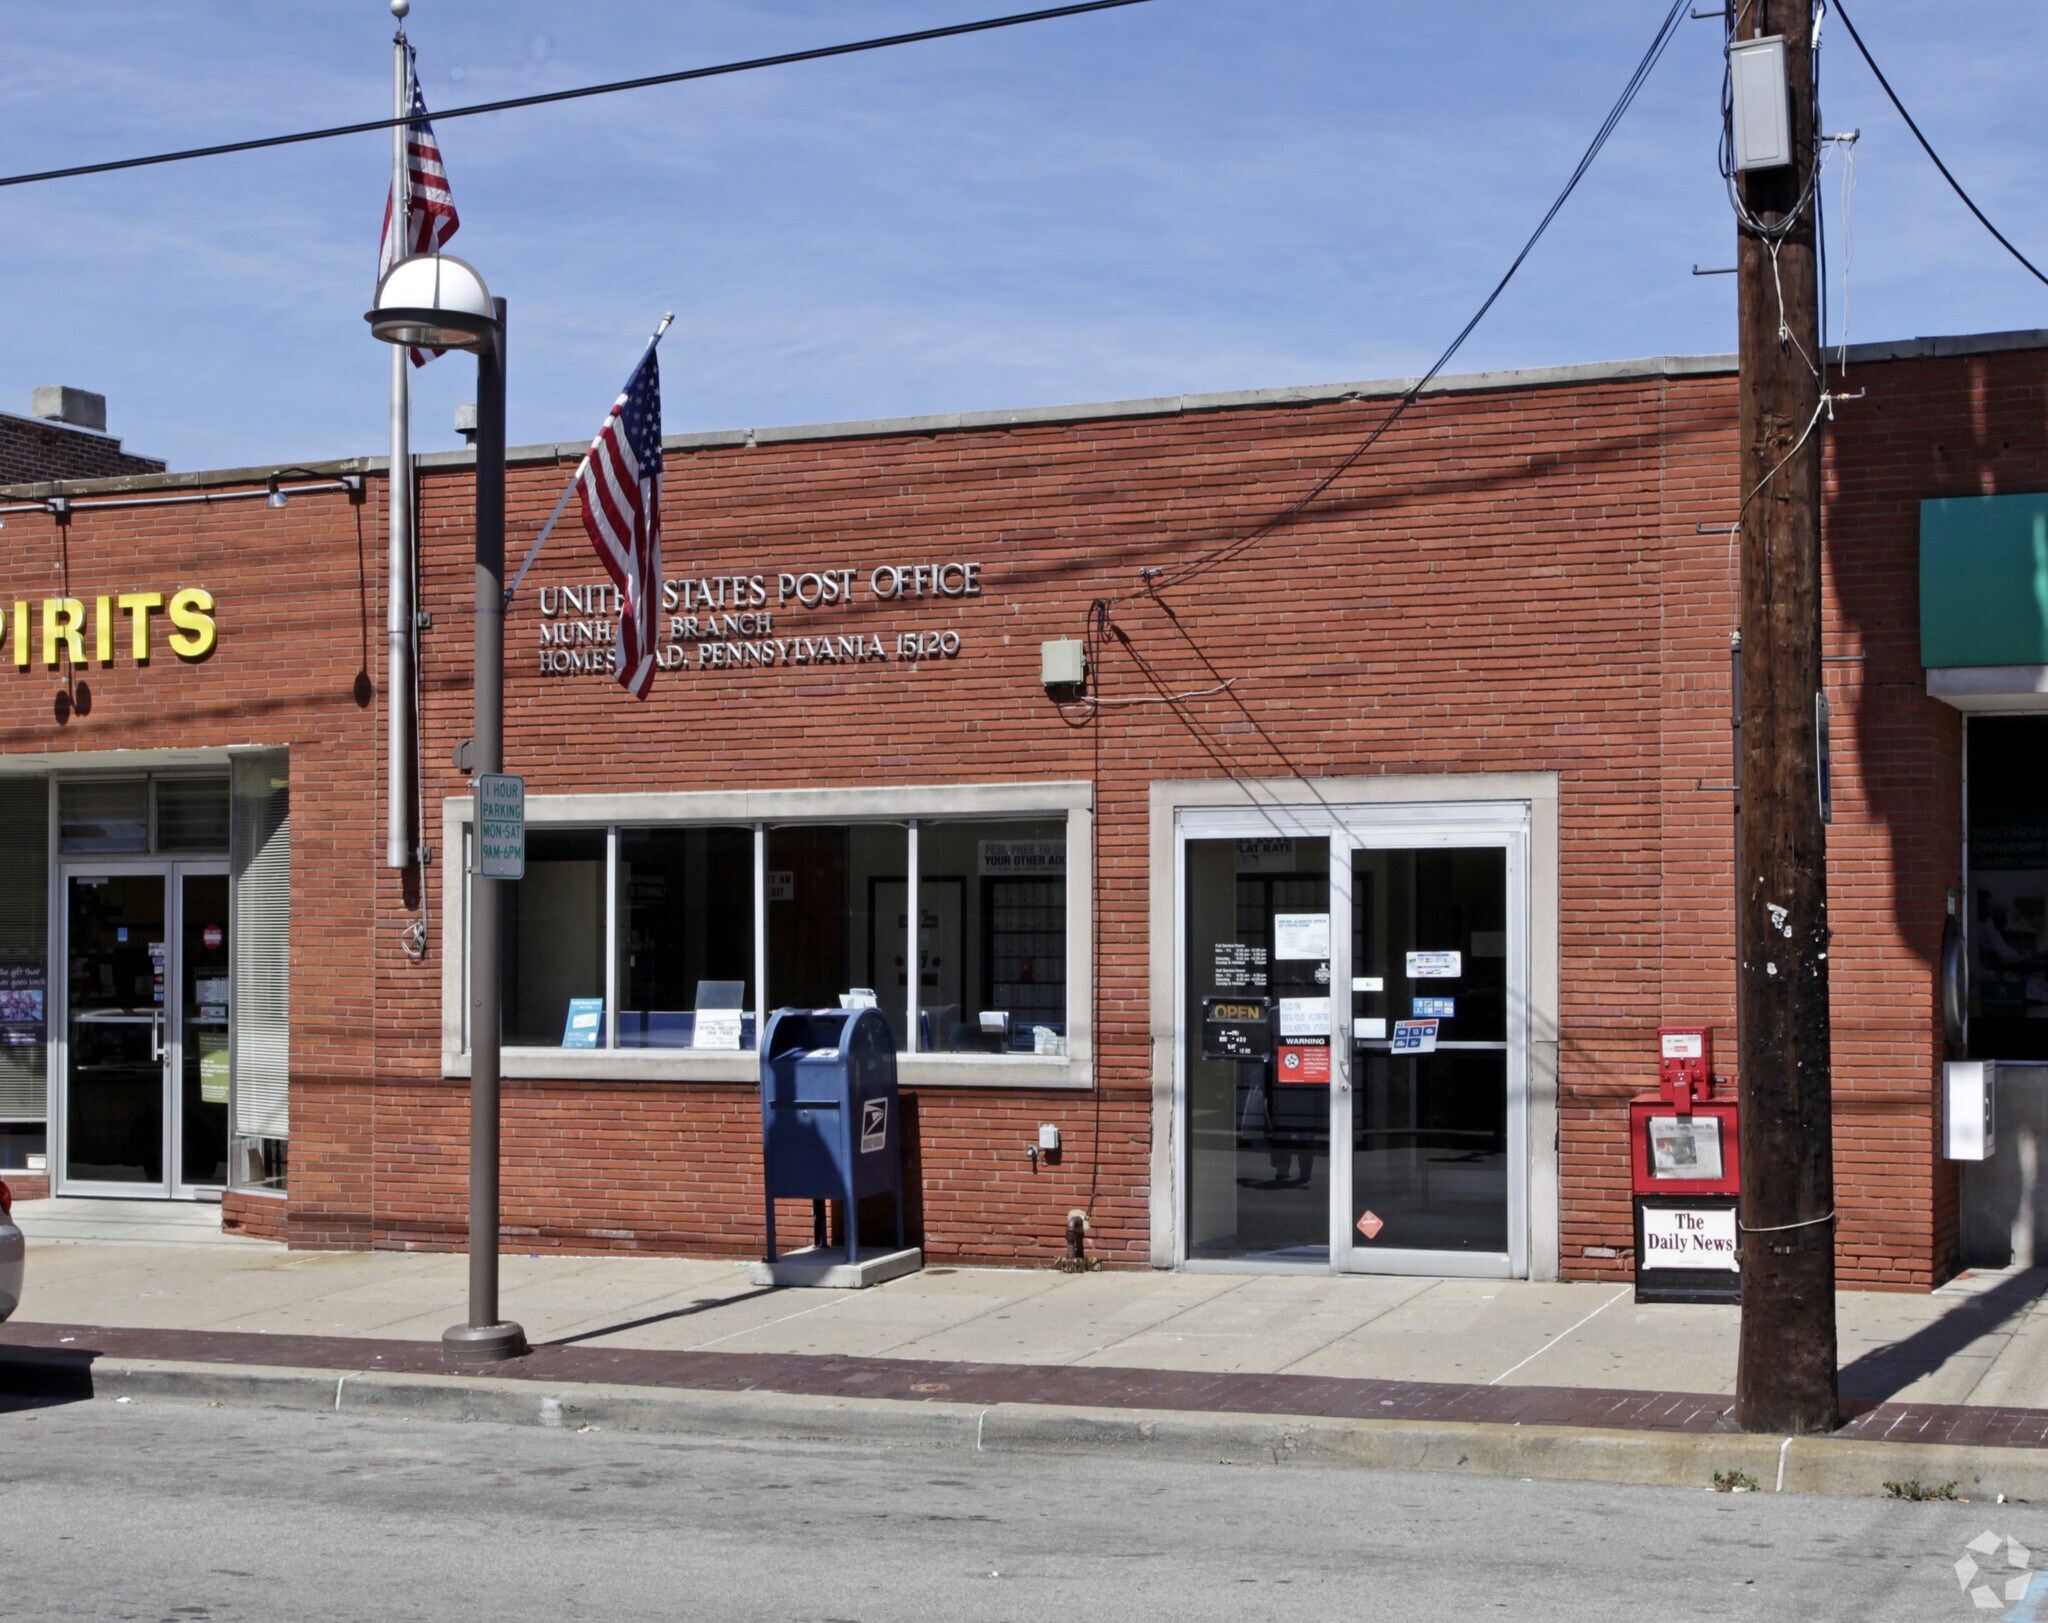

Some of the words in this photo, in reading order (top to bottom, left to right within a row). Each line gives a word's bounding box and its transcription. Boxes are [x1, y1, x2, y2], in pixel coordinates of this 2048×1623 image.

[540, 583, 626, 616] UNITE
[662, 575, 766, 610] STATES
[778, 569, 857, 606] POST
[871, 563, 980, 598] OFFICE
[0, 588, 216, 666] IRITS
[539, 620, 616, 644] MUNH
[670, 612, 772, 638] BRANCH
[698, 634, 886, 664] PENNSYLVANIA
[896, 631, 960, 655] 15120
[485, 783, 489, 797] 1
[493, 783, 518, 798] HOUR
[483, 803, 521, 818] PARKING
[483, 824, 521, 839] MON-SAT
[1973, 826, 2044, 838] SUCCESSFUL
[483, 845, 521, 860] 9AM-6PM
[985, 844, 1006, 855] FEEL
[1011, 844, 1035, 854] FREE
[1039, 843, 1051, 854] TO
[1263, 843, 1292, 853] RATE
[1973, 842, 2043, 853] OWNERSHIP
[985, 855, 1011, 866] YOUR
[1014, 855, 1046, 866] OTHER
[1215, 1005, 1259, 1019] OPEN
[1675, 1213, 1704, 1230] The
[1648, 1233, 1688, 1253] Daily
[1692, 1234, 1733, 1251] News
